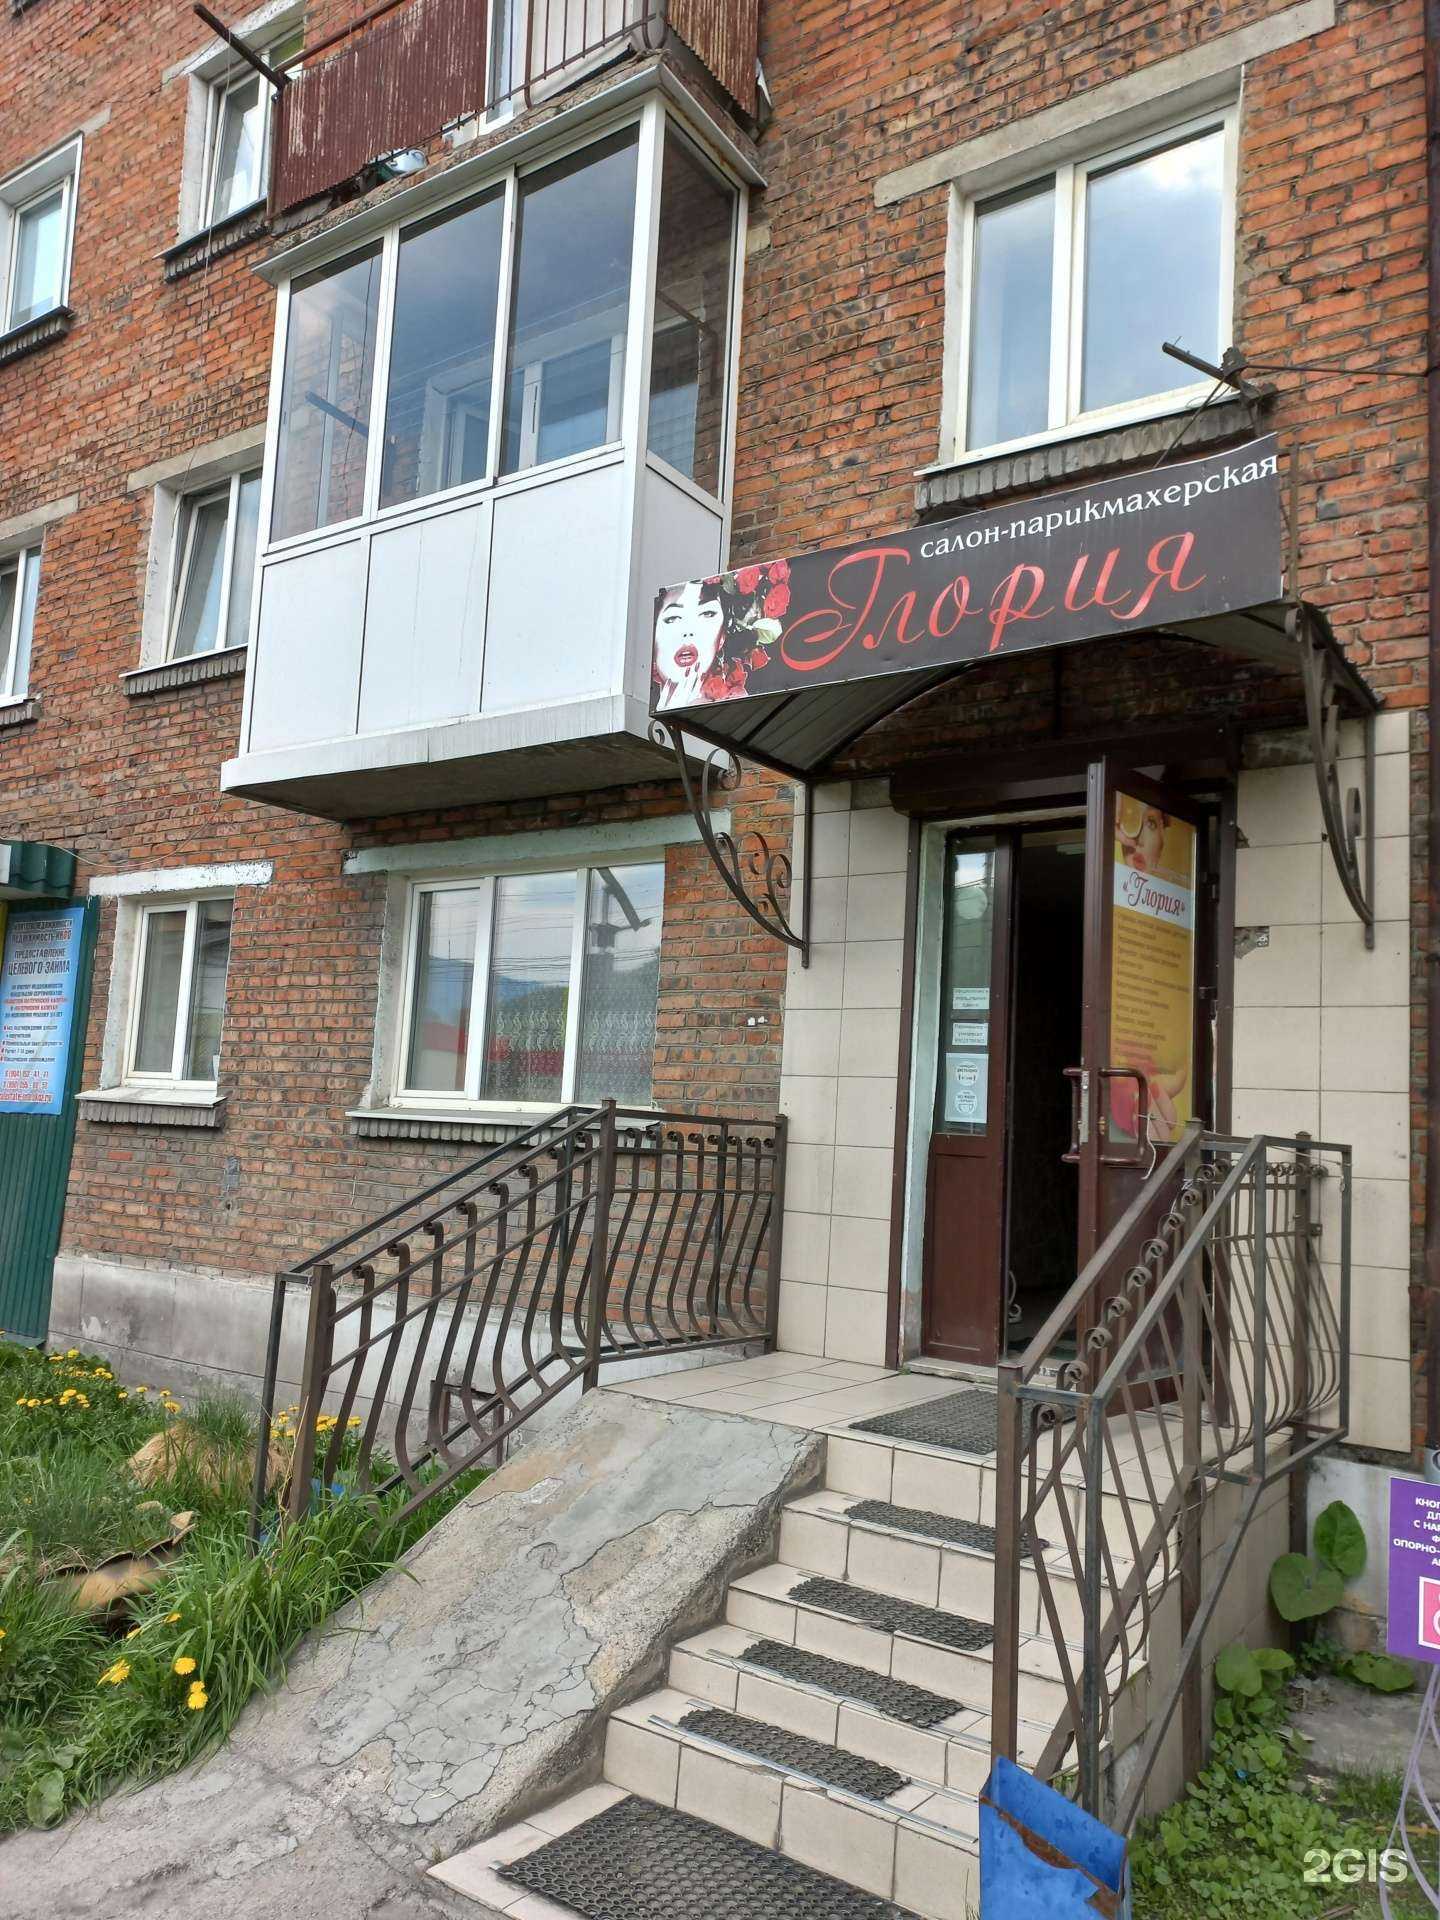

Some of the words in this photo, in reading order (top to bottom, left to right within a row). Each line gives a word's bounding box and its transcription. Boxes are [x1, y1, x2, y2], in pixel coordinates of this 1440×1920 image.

[919, 454, 1279, 559] салон-парикмахерская
[780, 531, 1207, 671] Глория
[1413, 1519, 1421, 1528] С
